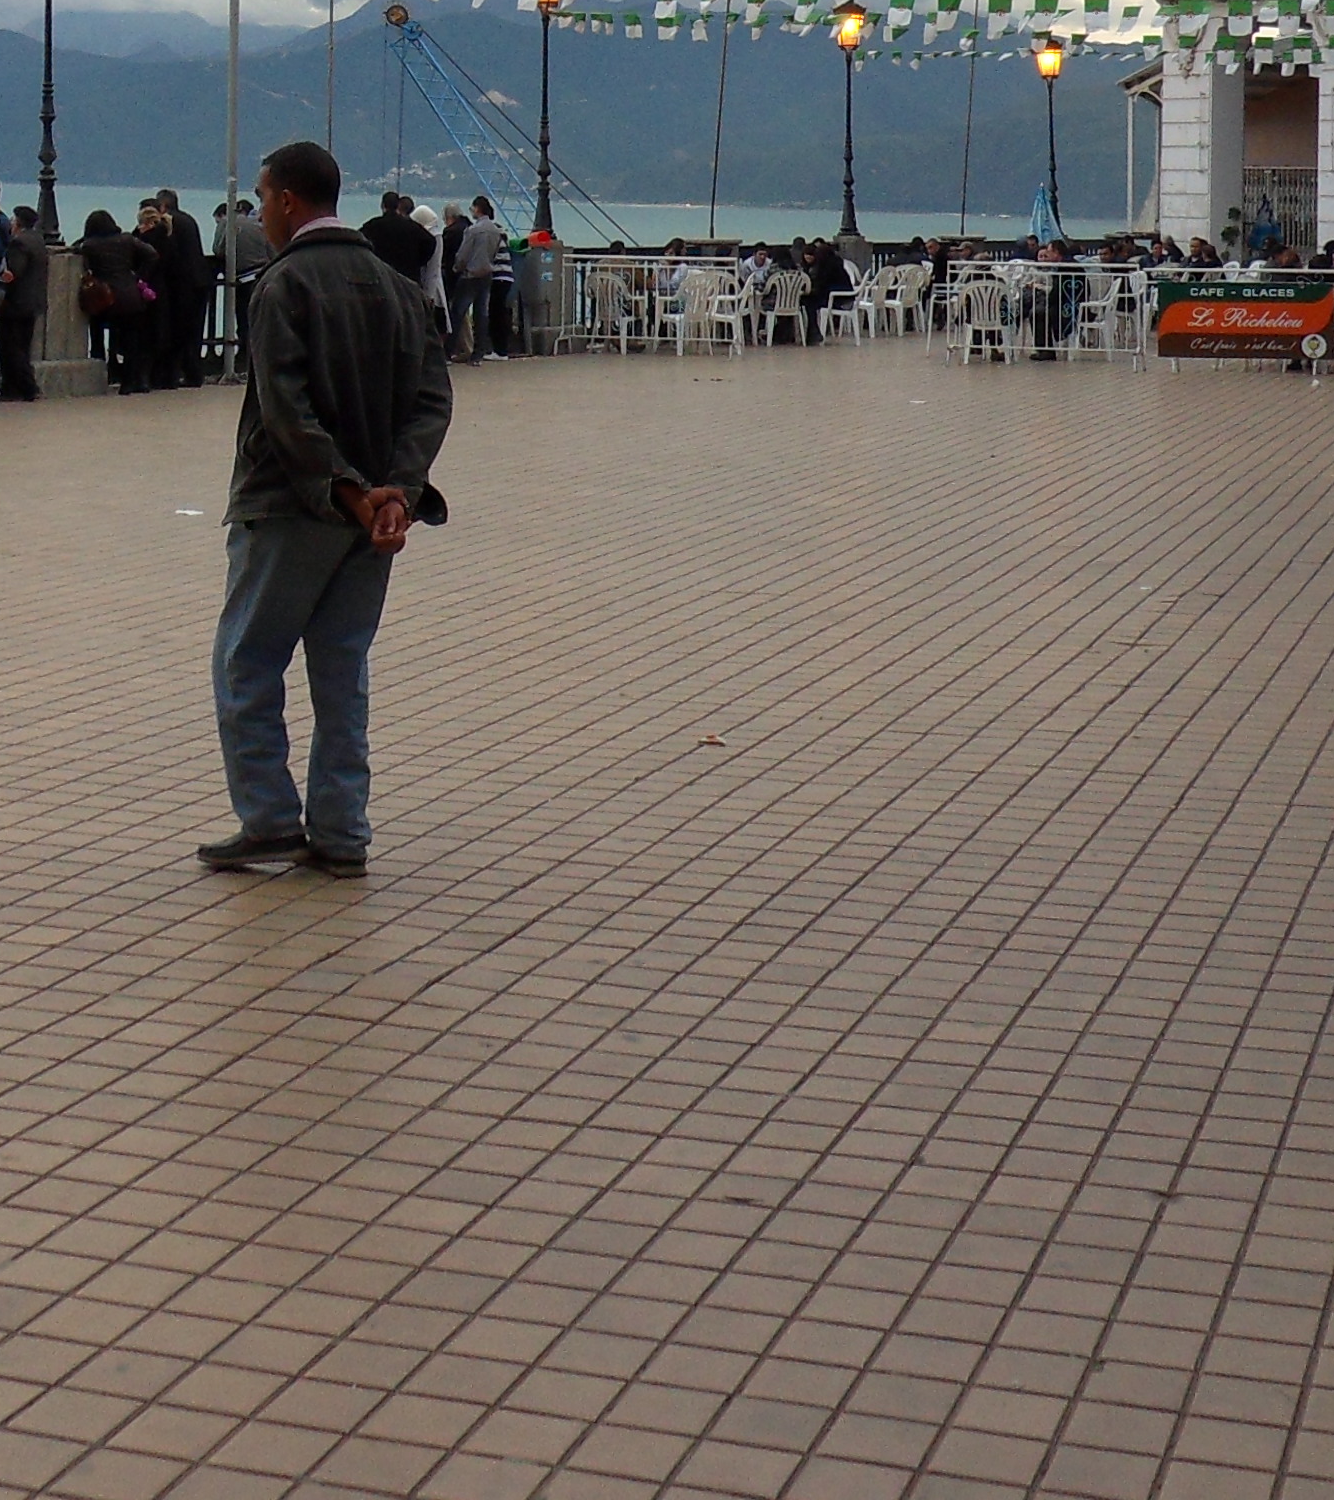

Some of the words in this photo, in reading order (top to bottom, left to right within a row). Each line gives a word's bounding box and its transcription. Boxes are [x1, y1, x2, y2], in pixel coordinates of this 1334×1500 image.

[1190, 287, 1225, 297] CAFE
[1242, 288, 1295, 298] GLACES
[1187, 306, 1215, 327] Le
[1220, 307, 1304, 328] Richelieu
